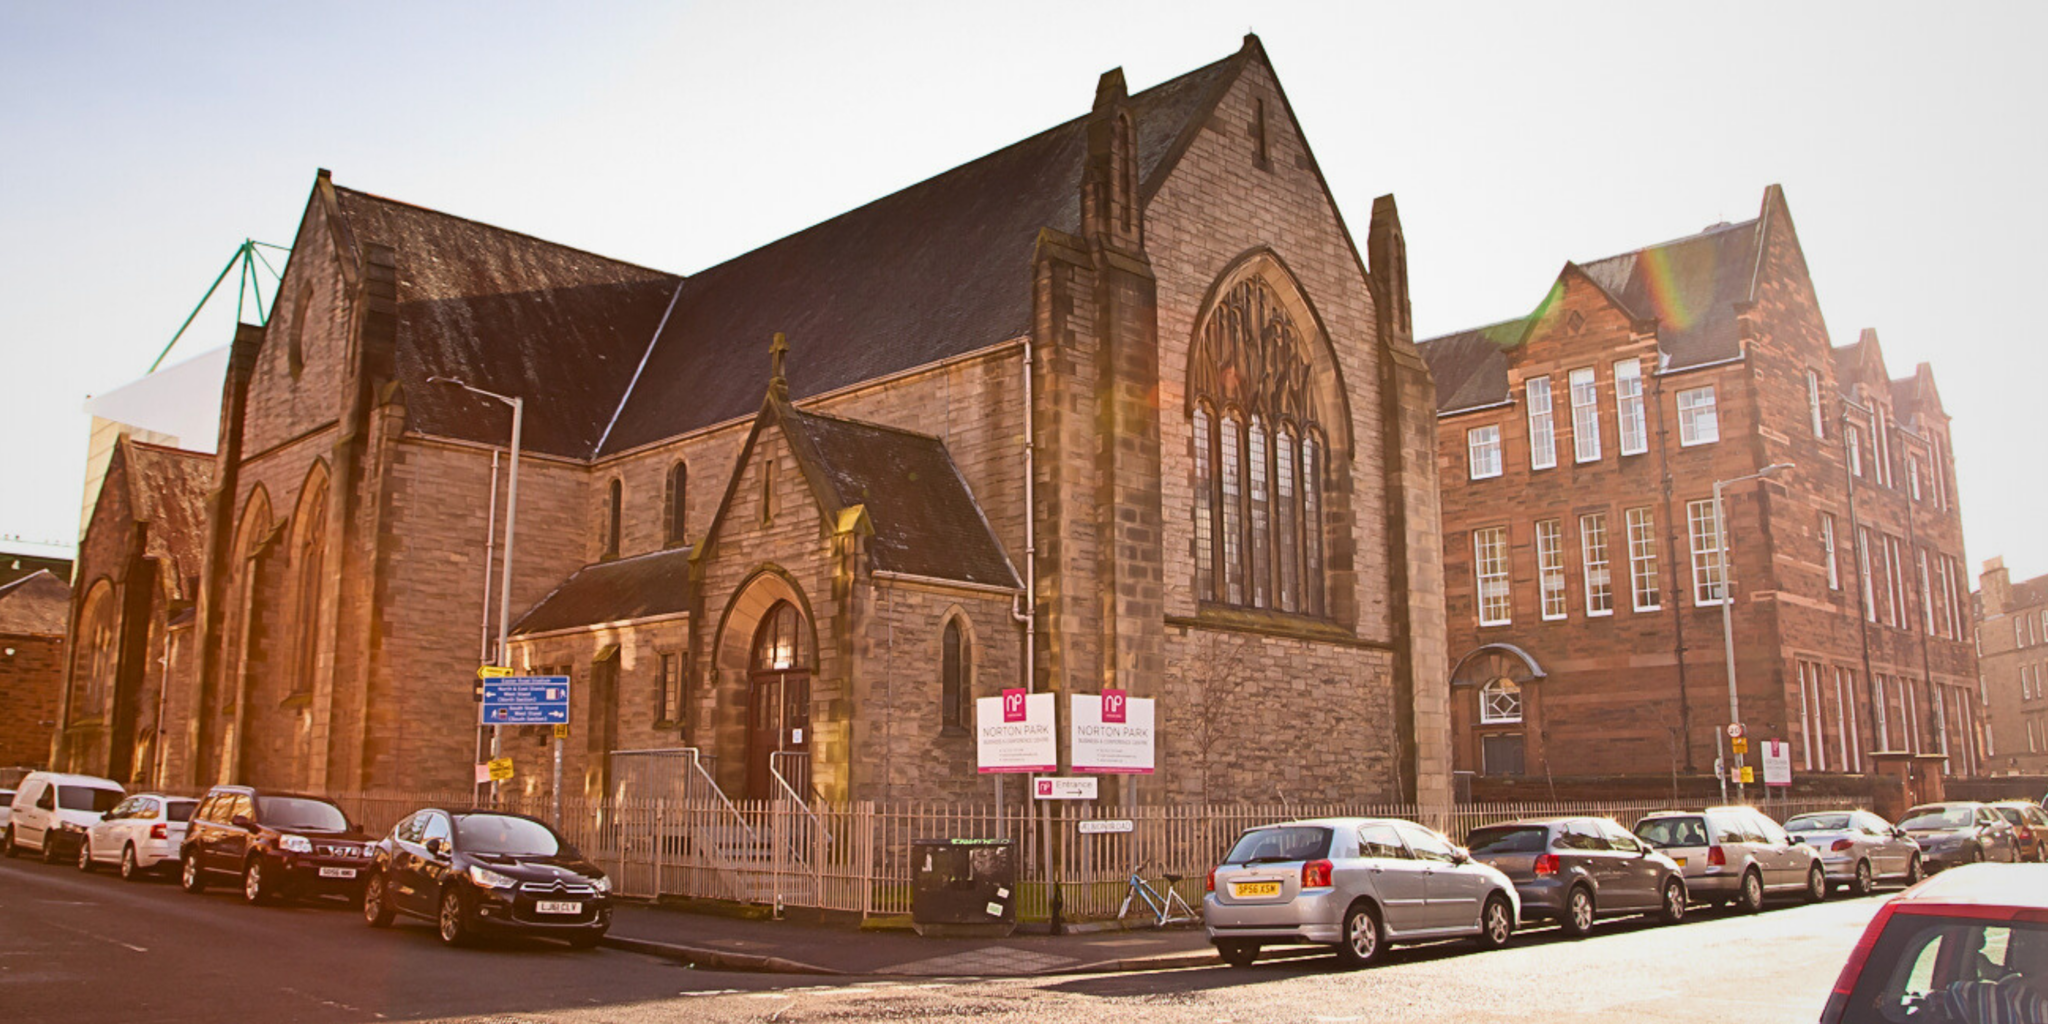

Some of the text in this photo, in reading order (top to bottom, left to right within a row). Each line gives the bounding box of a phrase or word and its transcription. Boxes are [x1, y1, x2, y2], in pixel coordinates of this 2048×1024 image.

[983, 725, 1049, 737] NORTON PARK
[1078, 725, 1148, 737] NORTON PARK
[1056, 780, 1092, 788] Entrance
